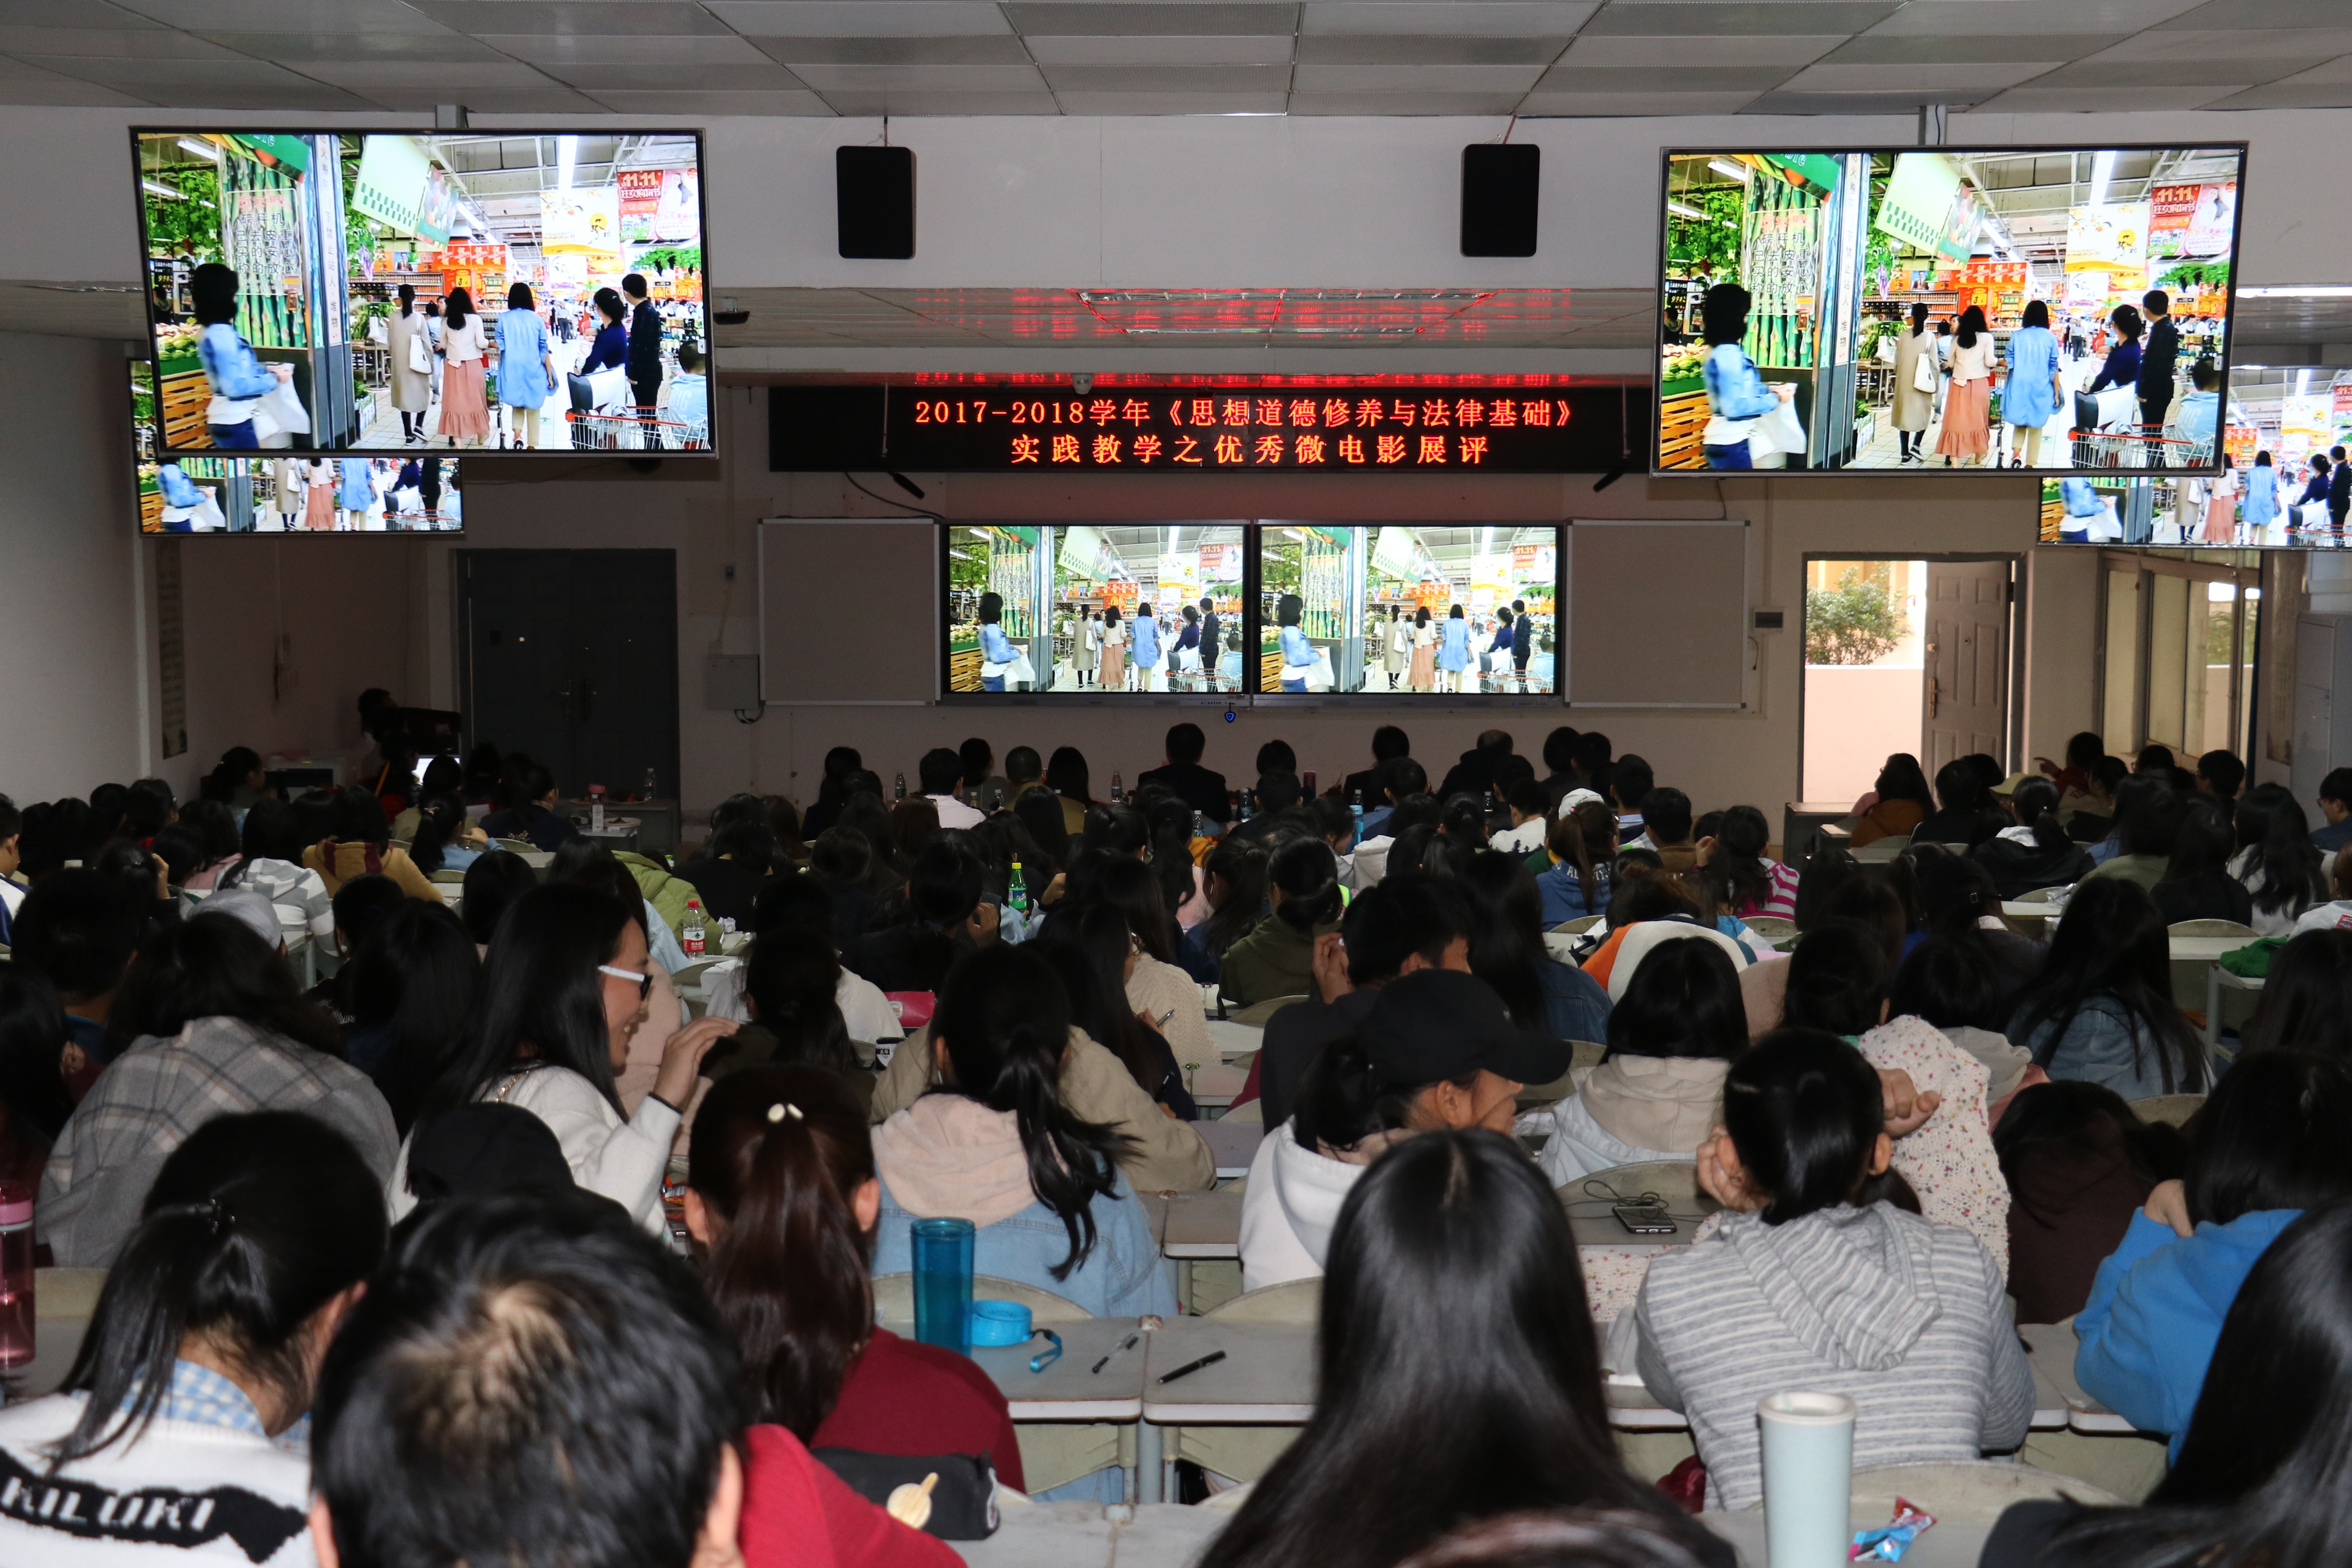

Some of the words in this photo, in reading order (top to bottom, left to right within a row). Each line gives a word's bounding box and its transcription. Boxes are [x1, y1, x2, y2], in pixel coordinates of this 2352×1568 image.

[623, 172, 656, 187] 11.11
[2158, 187, 2192, 202] 11.11
[241, 212, 285, 225] 磅秤机
[1762, 232, 1804, 245] 磅秤机
[236, 246, 292, 258] 买的安心
[237, 261, 293, 274] 称的放心
[1753, 265, 1809, 278] 买的安心
[1751, 281, 1808, 294] 称的放心
[915, 398, 1571, 428] 2017-2018学年《思想道德修养与法律基础》
[1011, 434, 1488, 465] 实践教学之优秀微电影展评
